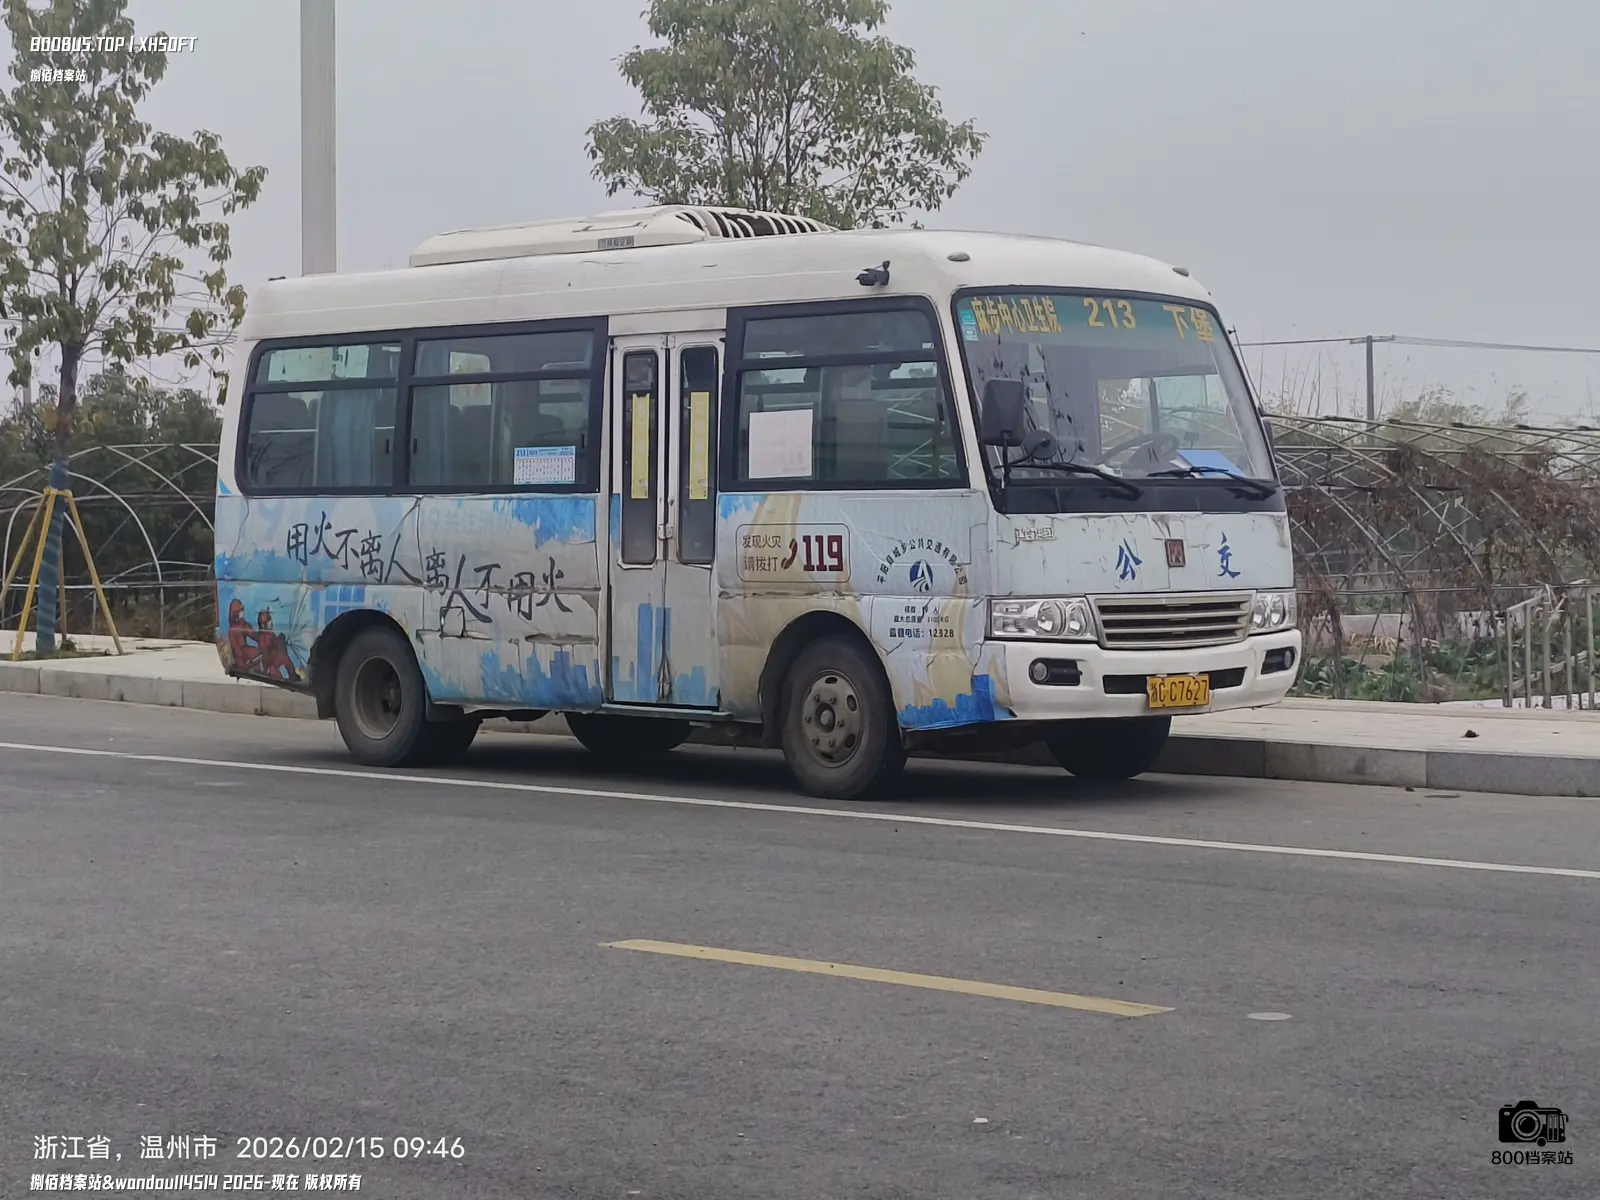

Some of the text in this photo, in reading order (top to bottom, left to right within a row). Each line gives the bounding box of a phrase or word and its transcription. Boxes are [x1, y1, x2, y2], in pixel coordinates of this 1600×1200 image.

[970, 295, 1062, 336] 麻步中心卫生院
[1083, 298, 1136, 329] 213
[1162, 305, 1216, 342] 下堡
[742, 534, 782, 549] 发现火灾
[802, 535, 844, 571] 119
[1115, 532, 1241, 581] 公 交
[286, 511, 573, 624] 用火不离人 离人不用火
[744, 556, 779, 572] 请拨打
